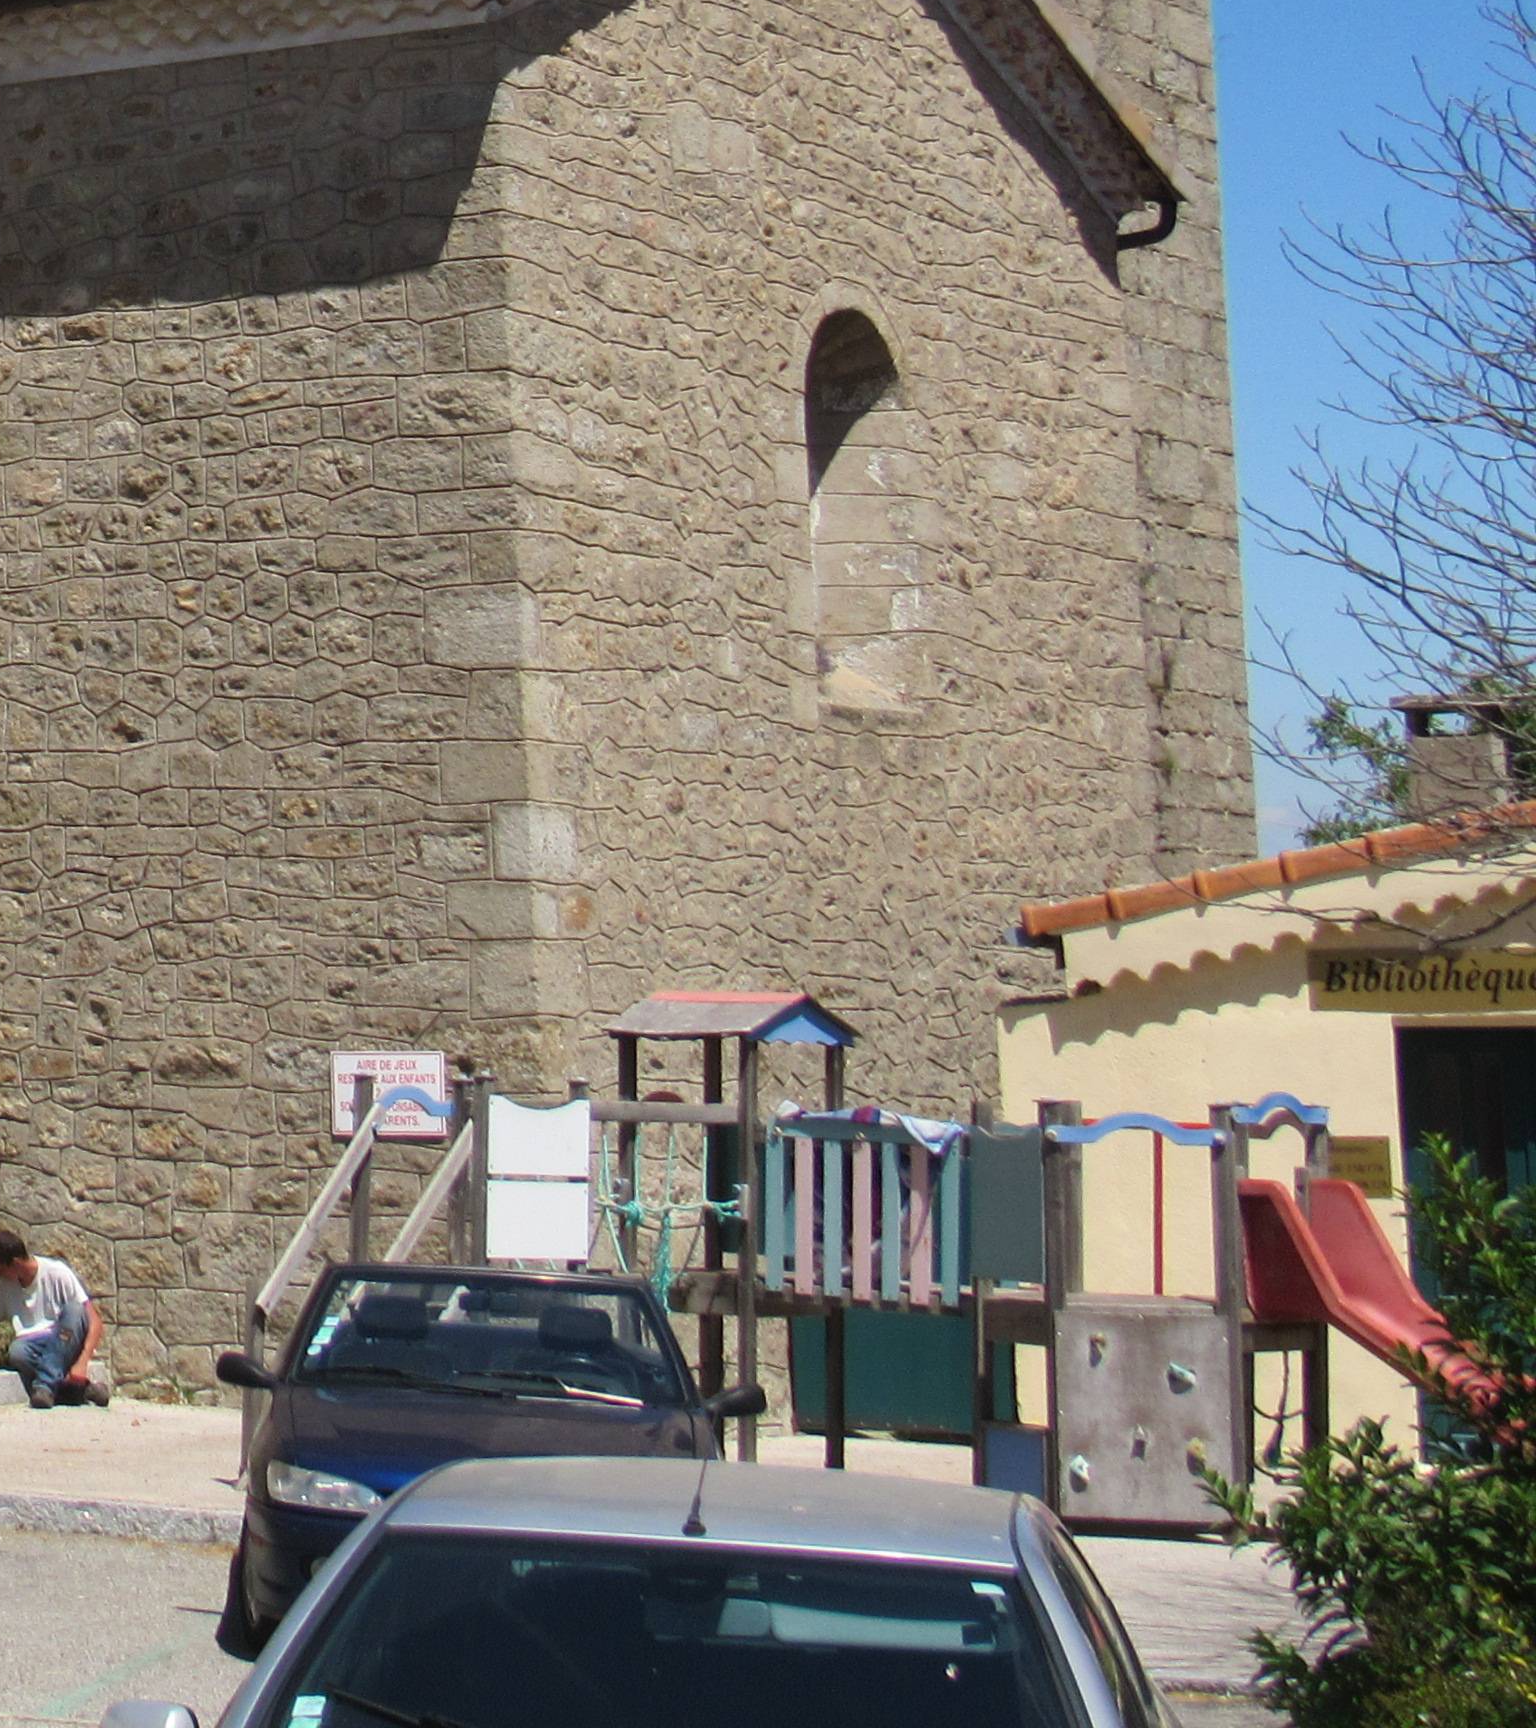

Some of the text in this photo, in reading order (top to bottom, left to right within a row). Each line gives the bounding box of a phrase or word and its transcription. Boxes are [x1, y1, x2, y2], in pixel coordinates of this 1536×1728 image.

[357, 1059, 417, 1070] AIRE DE JEUX
[381, 1074, 396, 1084] AUX
[399, 1074, 436, 1084] ENFANTS
